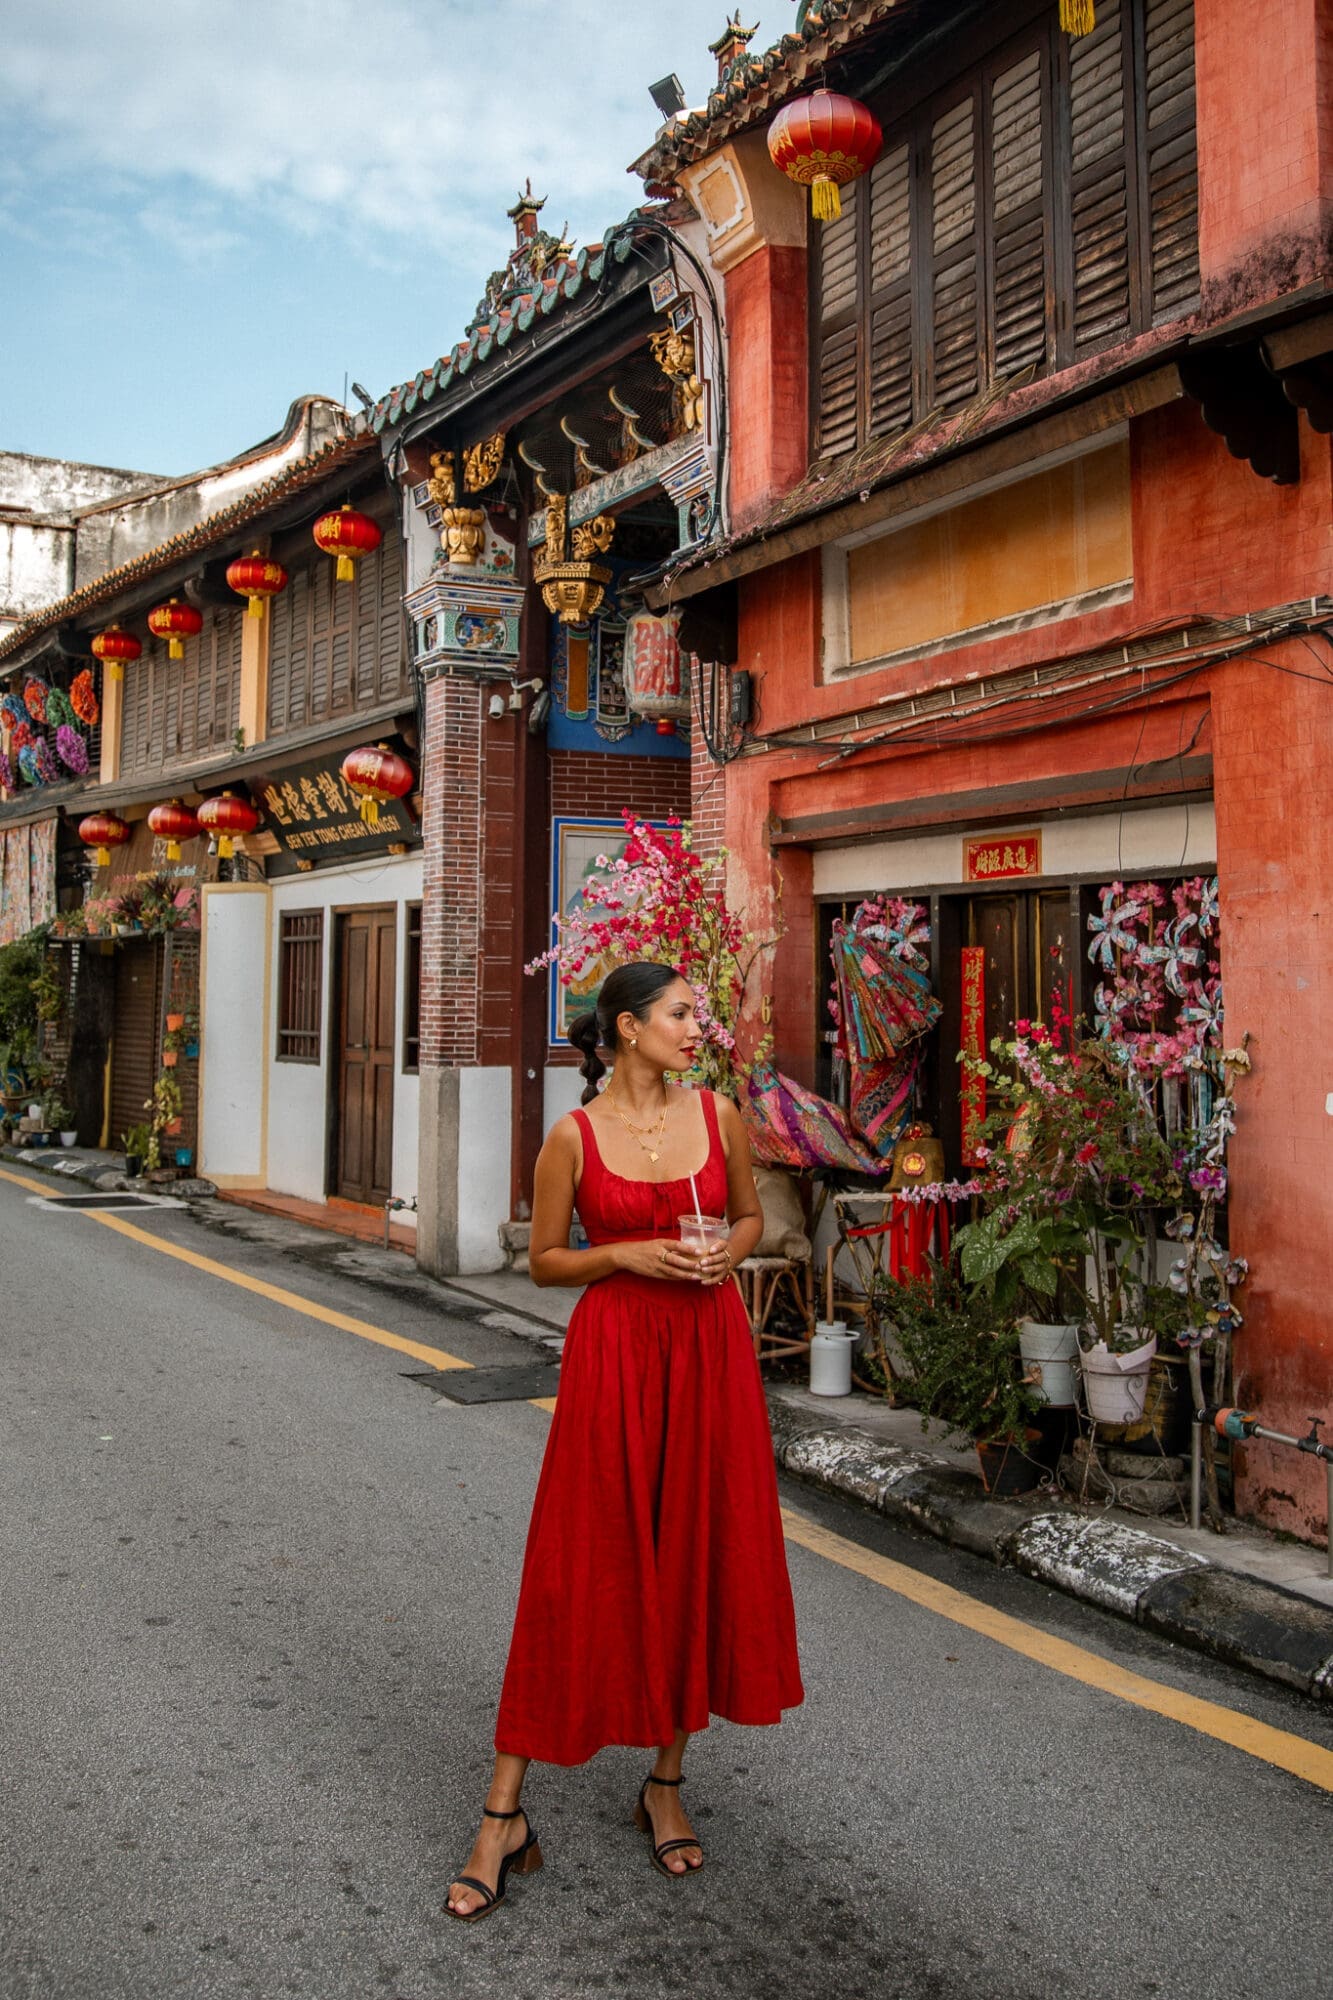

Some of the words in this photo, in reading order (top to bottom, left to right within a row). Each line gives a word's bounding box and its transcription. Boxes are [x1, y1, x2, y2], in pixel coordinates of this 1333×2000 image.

[300, 830, 320, 846] TEK
[315, 826, 340, 844] TONG
[338, 821, 368, 841] CHEAH
[366, 815, 402, 834] KONGSI
